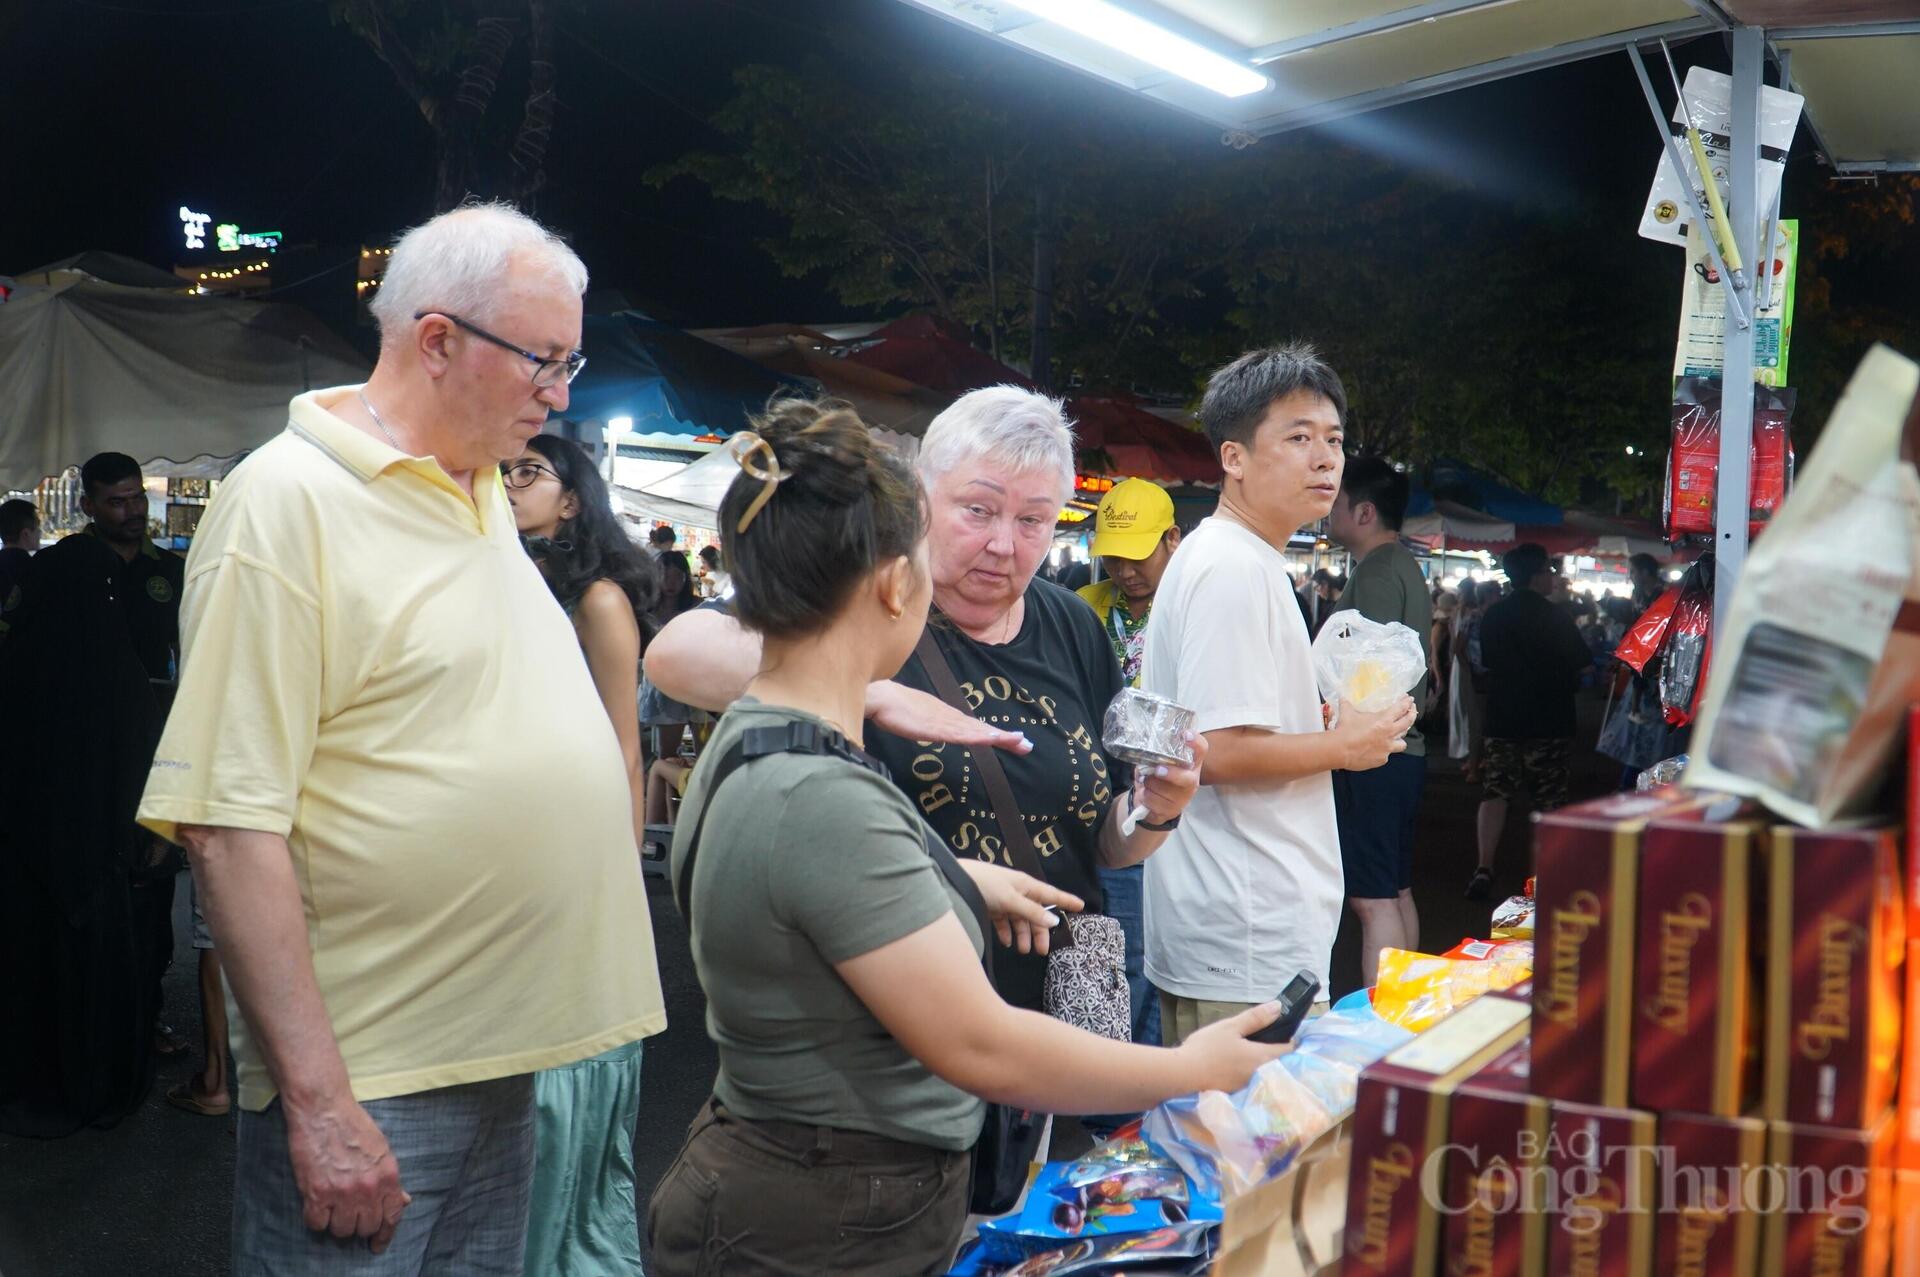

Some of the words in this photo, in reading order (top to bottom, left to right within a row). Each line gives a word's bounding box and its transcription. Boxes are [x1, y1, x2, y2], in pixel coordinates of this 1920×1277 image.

[979, 714, 1011, 724] UGO
[912, 741, 954, 815] BO
[1071, 722, 1110, 828] BOSS
[969, 808, 997, 820] OSS
[950, 822, 1065, 868] BSS
